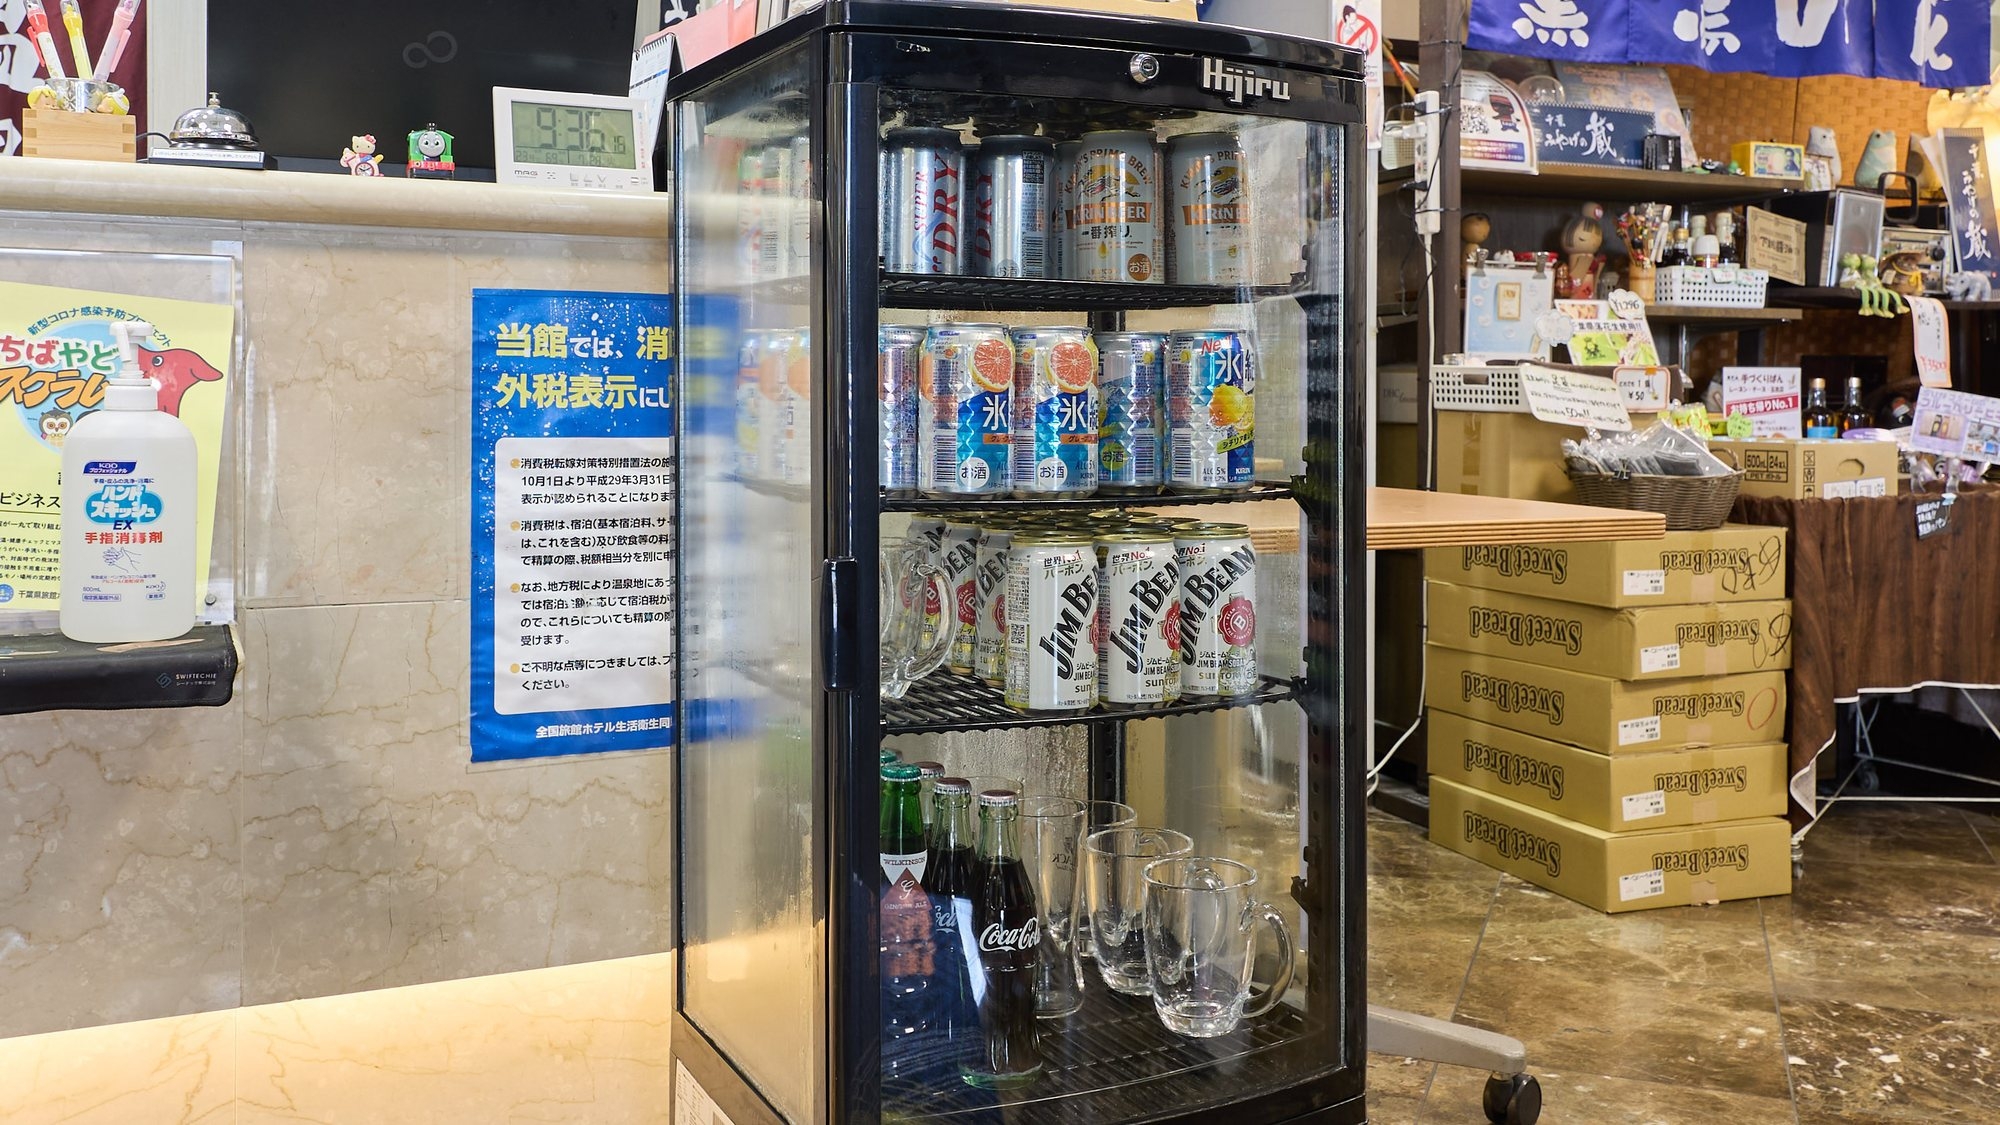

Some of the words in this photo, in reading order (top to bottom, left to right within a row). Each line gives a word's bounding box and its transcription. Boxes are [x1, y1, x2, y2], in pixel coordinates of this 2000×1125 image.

[1203, 56, 1291, 103] Hijiru
[1127, 155, 1153, 186] BREW
[914, 171, 929, 231] SUPER
[932, 145, 959, 257] DRY
[1107, 205, 1147, 220] BEER
[1129, 258, 1151, 275] お酒
[961, 465, 988, 480] お酒
[1040, 466, 1065, 479] お酒
[101, 486, 146, 501] ハンド
[90, 500, 157, 518] スキッシュ
[84, 531, 163, 545] 手指消毒剤
[112, 519, 134, 531] EX
[1513, 549, 1567, 584] Sweet
[1660, 551, 1705, 574] Bread
[1705, 548, 1749, 574] Sweet
[1184, 543, 1256, 609] BEAM
[1109, 602, 1154, 676] JIM
[1470, 607, 1523, 645] Bread
[1523, 617, 1582, 655] Sweet
[1676, 621, 1716, 646] Bread
[1717, 619, 1760, 644] Sweet
[521, 635, 570, 646] 受けます。
[1038, 606, 1084, 681] JIM
[521, 679, 570, 691] ください。
[1462, 671, 1512, 713] Bread
[1512, 681, 1564, 724] Sweet
[1653, 696, 1700, 718] Bread
[1700, 691, 1744, 717] Sweet
[1464, 741, 1512, 781] Bread
[1513, 751, 1564, 800] Sweet
[1655, 771, 1700, 796] Bread
[1700, 766, 1746, 794] Sweet
[1464, 811, 1511, 857] Bread
[883, 856, 926, 866] WILKINSON
[1510, 822, 1561, 877] Sweet
[1653, 850, 1700, 874] Bread
[1700, 845, 1749, 871] Sweet
